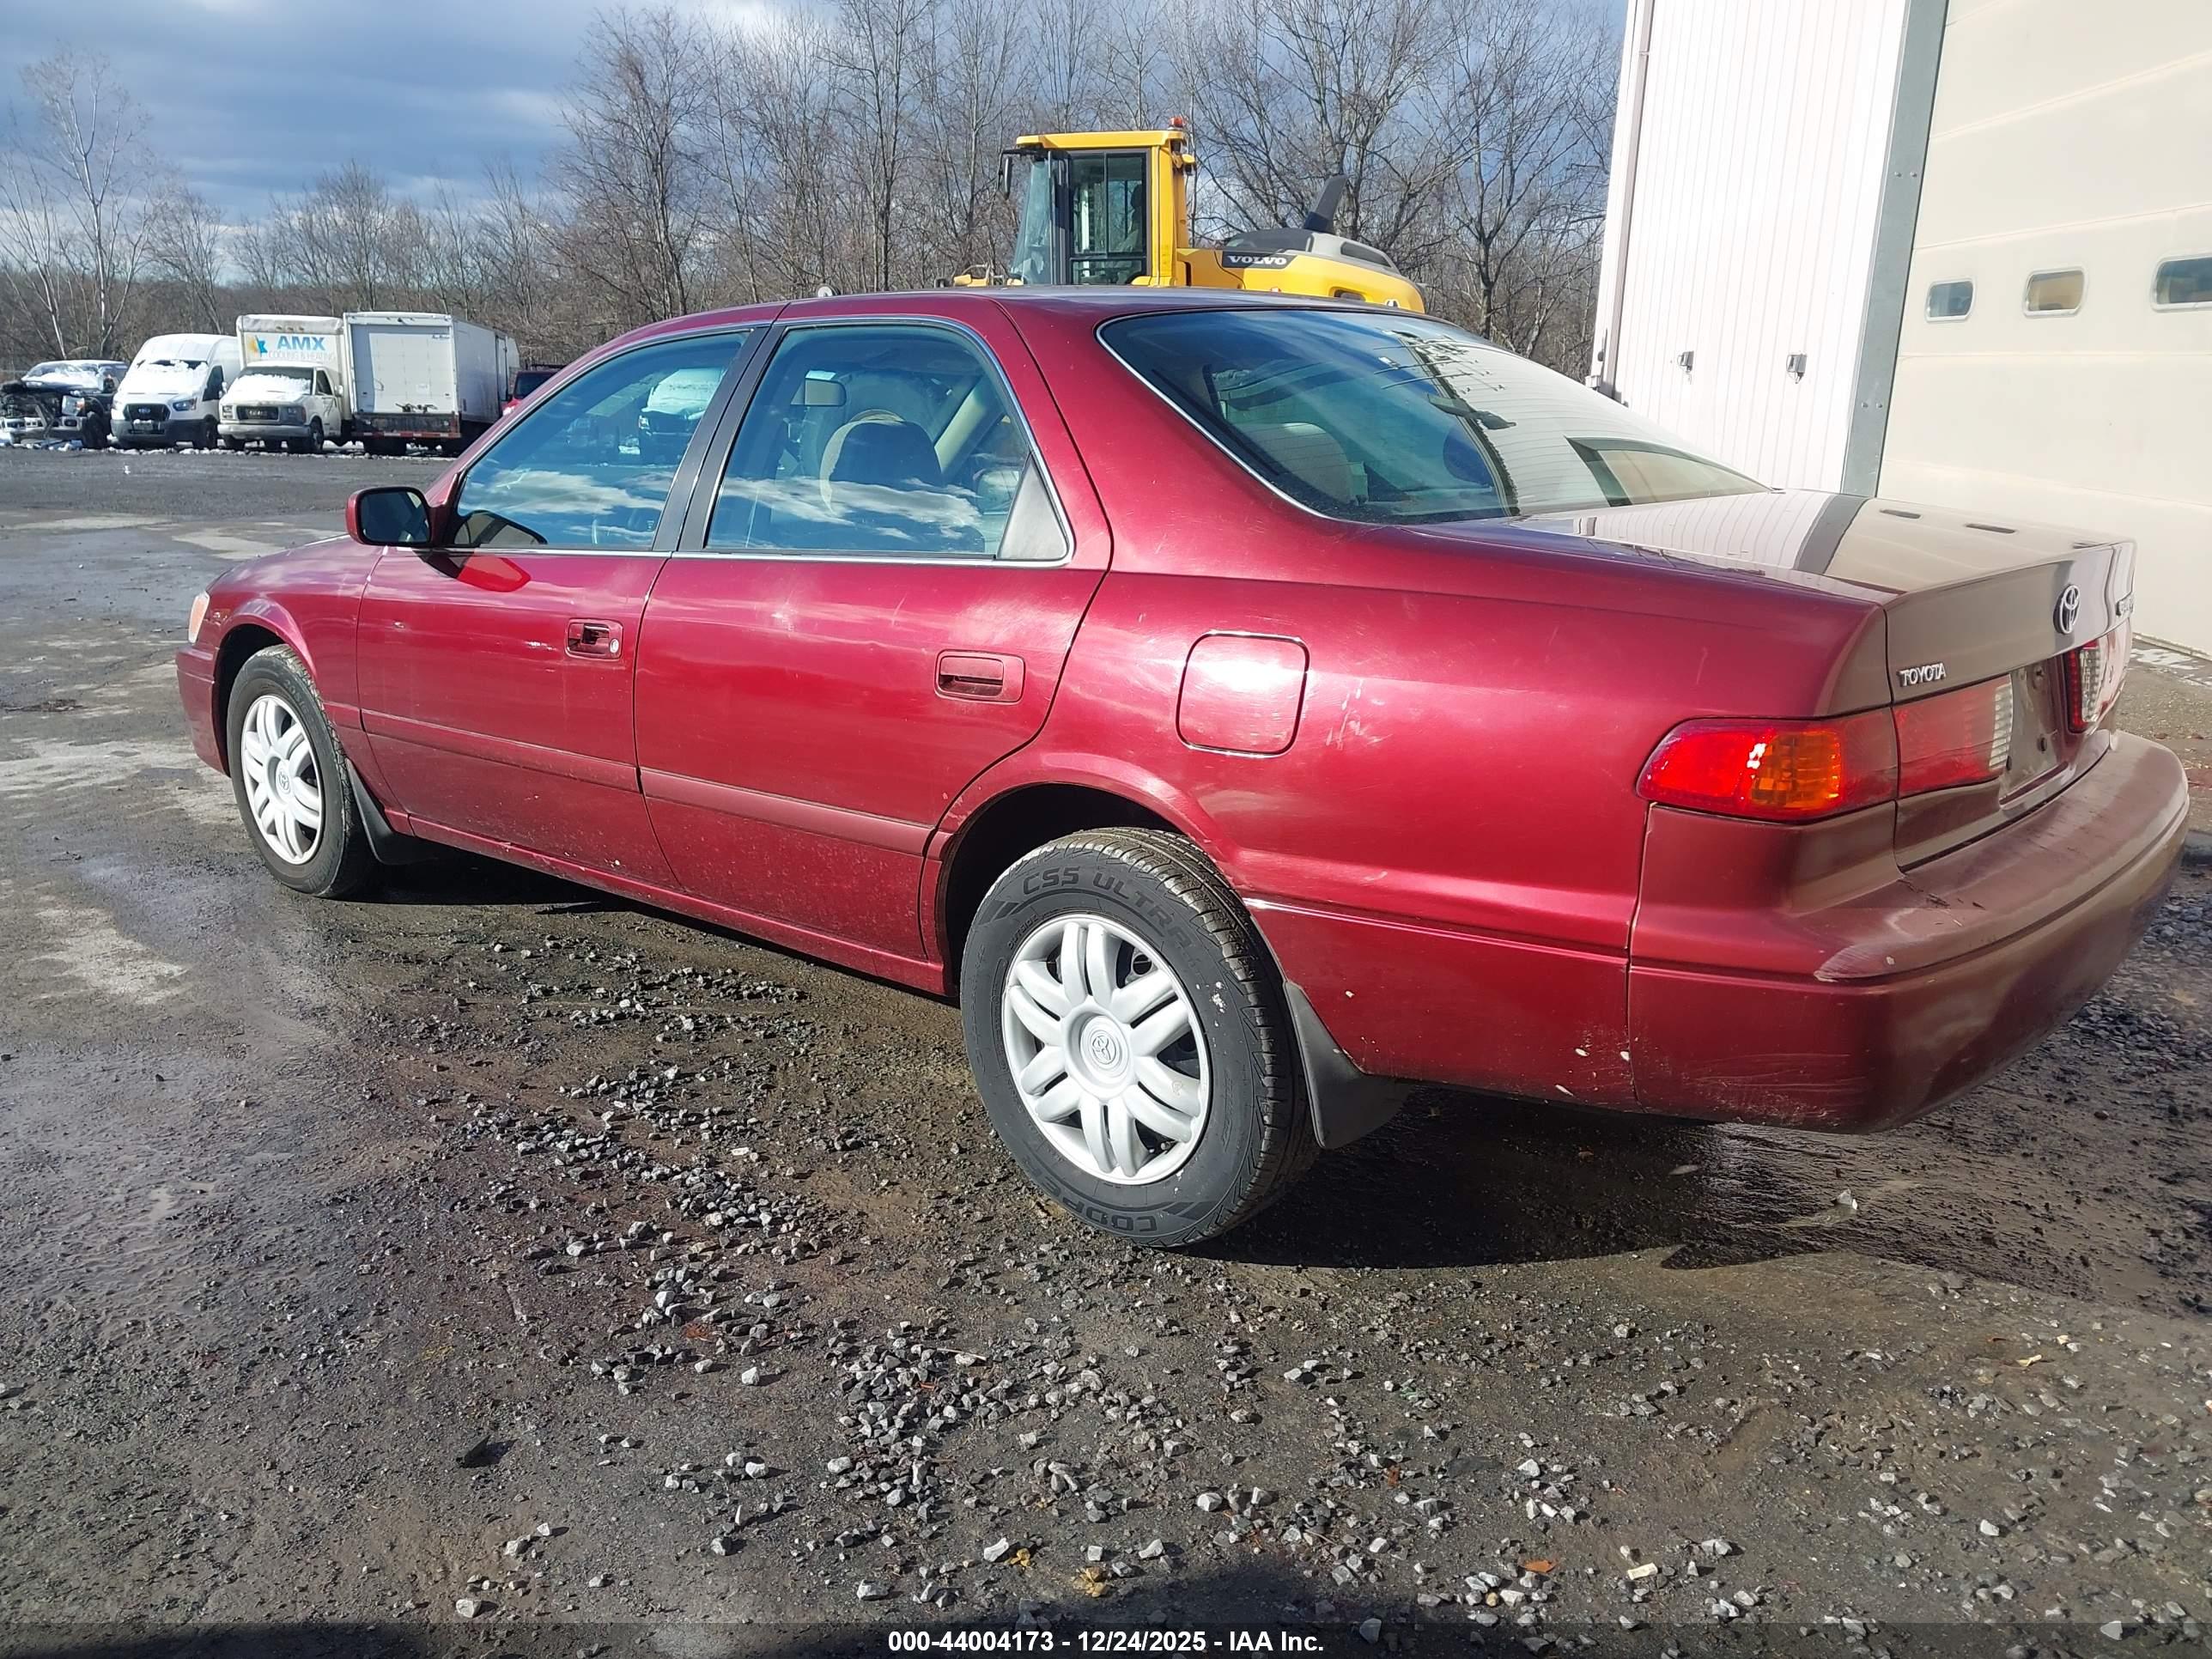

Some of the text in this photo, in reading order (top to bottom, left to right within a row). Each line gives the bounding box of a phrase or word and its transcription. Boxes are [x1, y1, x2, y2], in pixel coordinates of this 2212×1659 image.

[1229, 255, 1287, 265] VOLVO
[277, 336, 325, 350] AMX
[1899, 662, 1947, 687] TOYOTA
[1092, 872, 1192, 947] ULTRA
